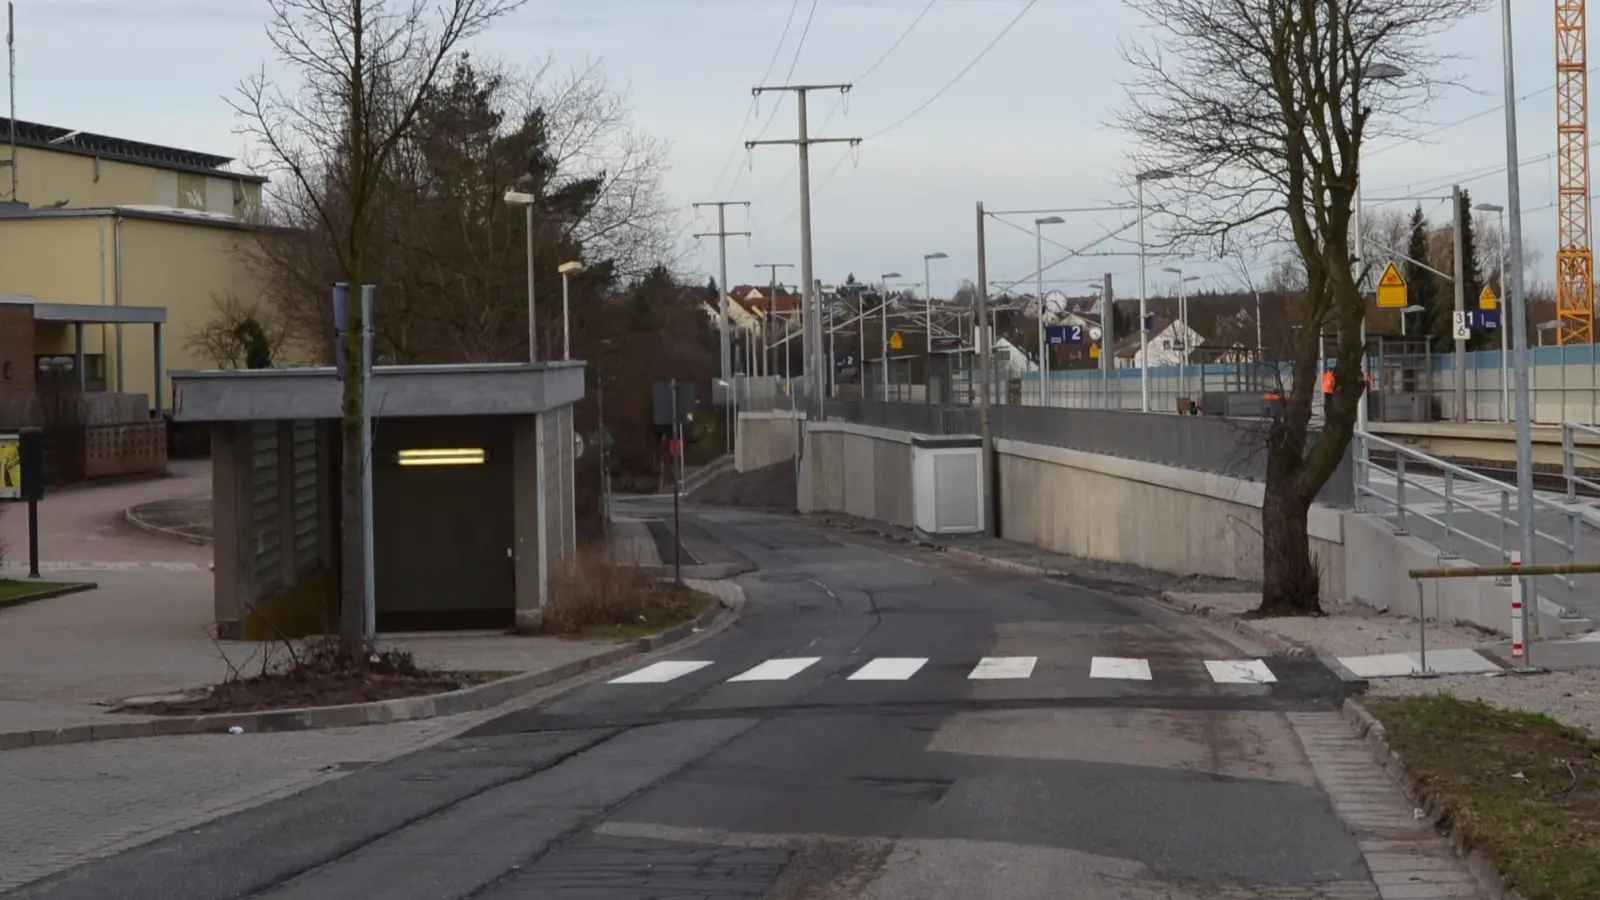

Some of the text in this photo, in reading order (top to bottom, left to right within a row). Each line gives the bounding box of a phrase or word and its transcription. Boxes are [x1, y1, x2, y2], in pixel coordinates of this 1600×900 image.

[1456, 312, 1463, 325] 3
[1466, 311, 1473, 326] 1
[1071, 325, 1081, 340] 2
[1458, 325, 1465, 337] 6
